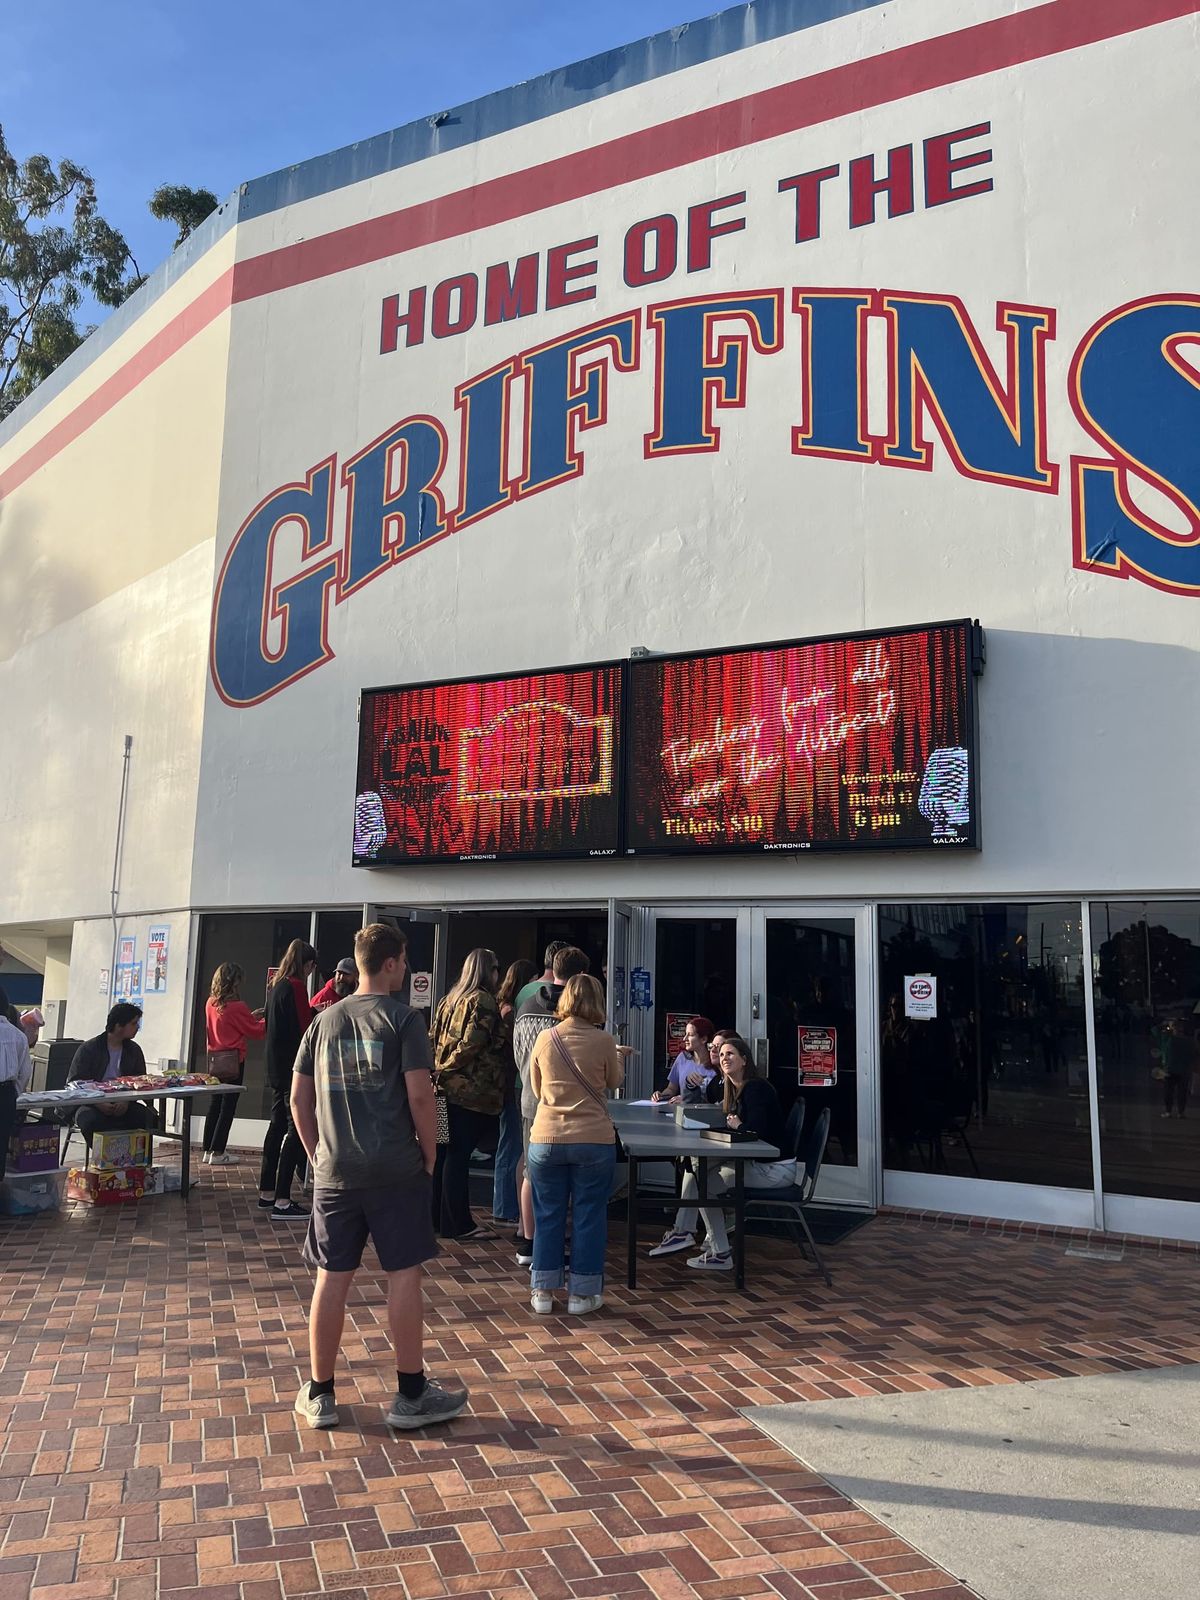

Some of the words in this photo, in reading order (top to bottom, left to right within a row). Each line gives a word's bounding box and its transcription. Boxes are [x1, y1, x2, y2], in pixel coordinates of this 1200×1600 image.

[380, 235, 599, 355] HOME
[622, 190, 747, 288] OF
[777, 120, 995, 244] THE
[210, 286, 1200, 709] GRIFFINS
[660, 717, 764, 776] Teachers
[852, 642, 890, 684] all
[848, 791, 896, 806] March
[731, 814, 763, 833] $10
[871, 813, 901, 830] pm
[763, 842, 811, 850] DAKTRONICS
[151, 932, 166, 942] VOTE
